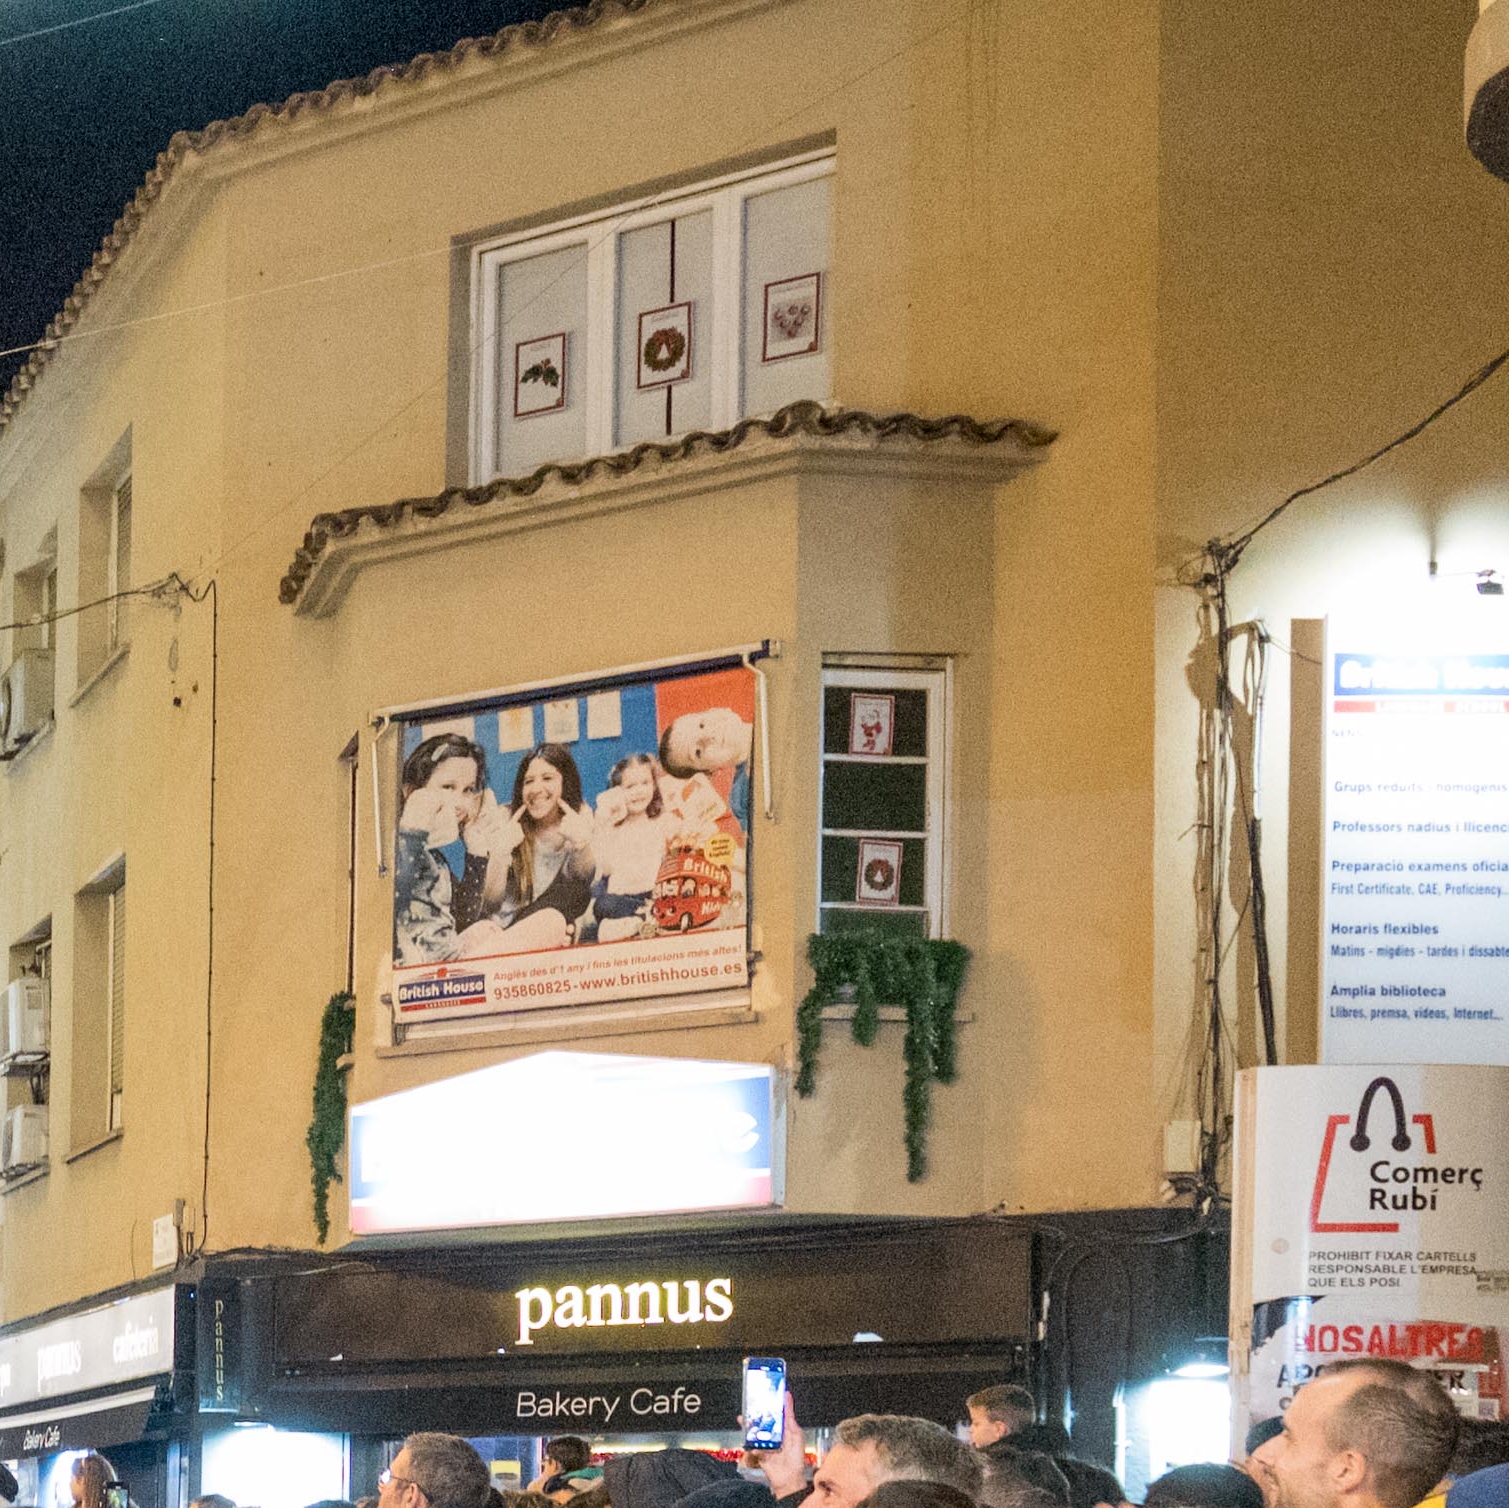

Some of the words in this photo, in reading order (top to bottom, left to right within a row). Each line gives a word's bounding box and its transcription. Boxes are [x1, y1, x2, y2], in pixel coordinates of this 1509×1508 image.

[1334, 781, 1373, 794] Grups
[1332, 820, 1403, 833] Professors
[1407, 821, 1451, 833] nadius
[684, 858, 728, 884] British
[1408, 862, 1468, 872] examens
[1331, 882, 1354, 895] First
[1331, 922, 1379, 935] Horaris
[1383, 923, 1439, 935] flexibles
[1331, 944, 1365, 957] Matins
[1426, 945, 1459, 957] tardes
[529, 967, 547, 978] des
[592, 959, 611, 969] fins
[613, 957, 629, 968] les
[630, 951, 684, 966] titulacions
[399, 983, 439, 1001] British
[442, 979, 485, 995] House
[1380, 985, 1446, 997] biblioteca
[1370, 1160, 1484, 1191] Comerç
[1369, 1186, 1438, 1211] Rubí
[1308, 1251, 1371, 1261] PROHIBIT
[1375, 1251, 1413, 1261] FIXAR
[1416, 1251, 1477, 1262] CARTELLS
[1308, 1263, 1407, 1274] RESPONSABLE
[1308, 1277, 1337, 1288] QUE
[1340, 1277, 1365, 1288] ELS
[515, 1278, 734, 1345] pannus
[214, 1299, 225, 1401] pannus
[516, 1390, 620, 1423] Bakery
[630, 1387, 701, 1415] Cafe
